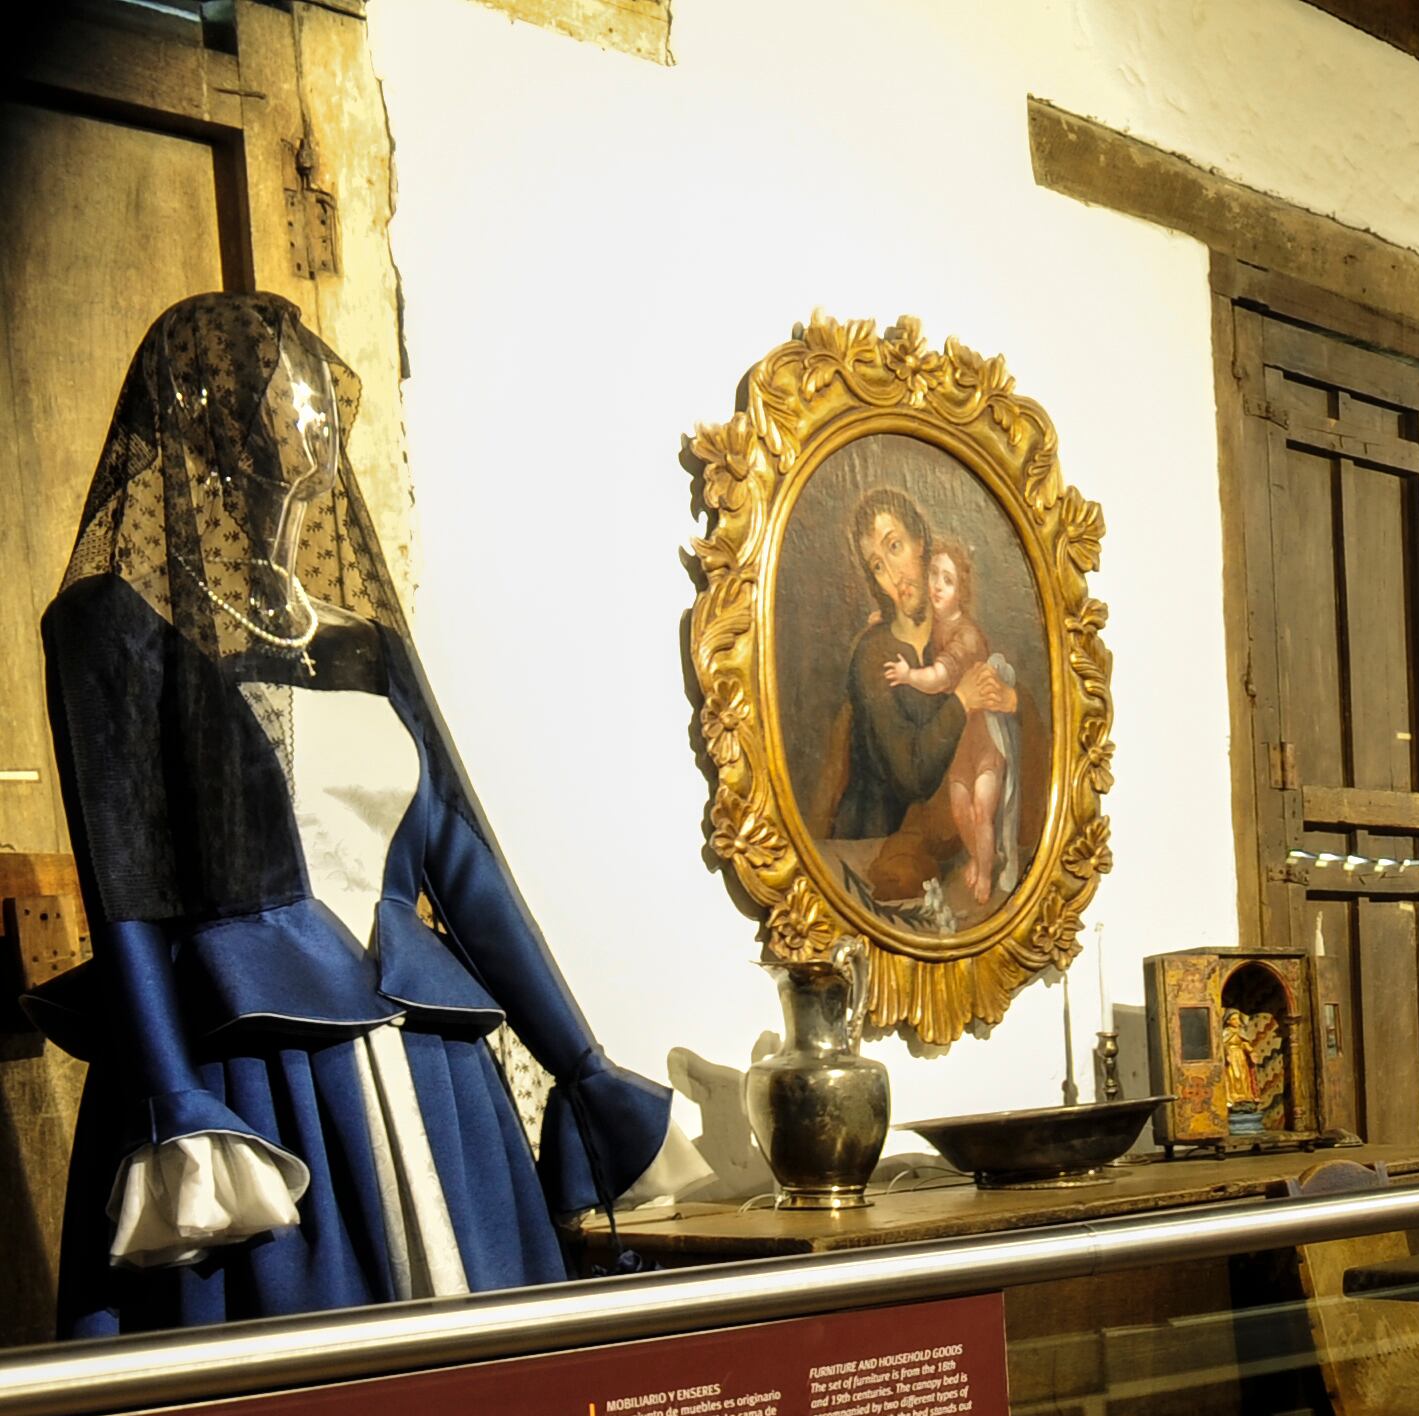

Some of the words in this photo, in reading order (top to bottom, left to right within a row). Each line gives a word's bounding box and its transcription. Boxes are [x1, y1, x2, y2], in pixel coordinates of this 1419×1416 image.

[606, 1392, 667, 1411] MOBILIARIO
[667, 1391, 675, 1401] Y
[677, 1383, 721, 1400] ENSERES
[680, 1400, 722, 1415] muebles
[723, 1399, 735, 1408] es
[736, 1390, 781, 1406] originario
[764, 1405, 777, 1416] de
